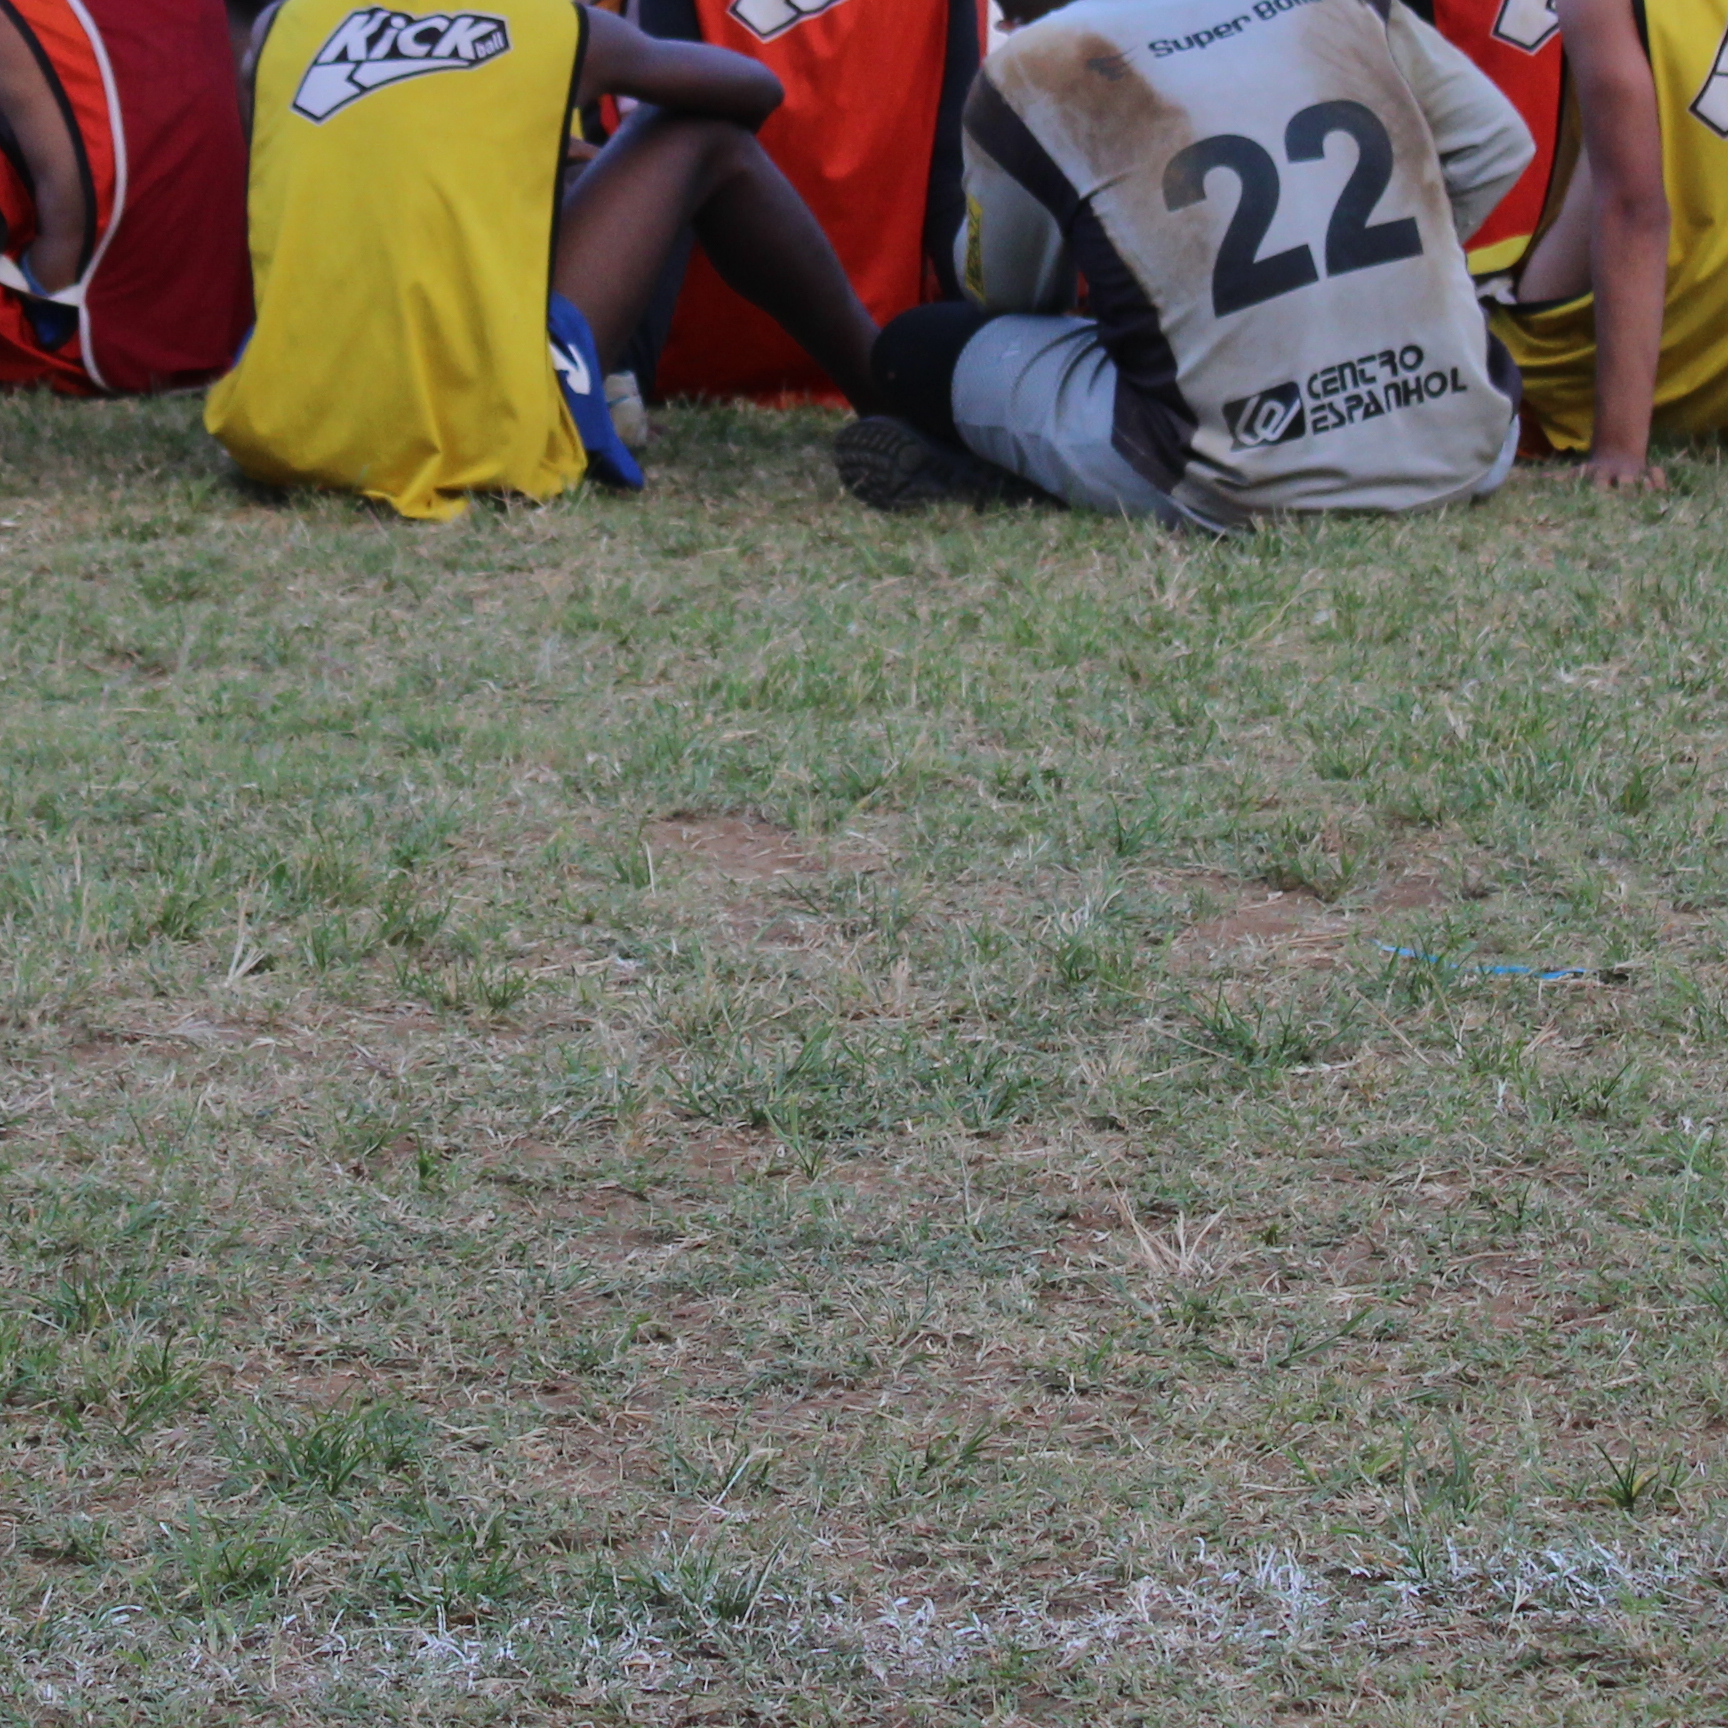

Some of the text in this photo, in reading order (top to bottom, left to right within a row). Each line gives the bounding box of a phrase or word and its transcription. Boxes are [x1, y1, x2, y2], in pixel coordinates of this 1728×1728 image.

[474, 31, 505, 59] ball
[1148, 14, 1251, 58] Super
[1162, 99, 1424, 319] 22
[1306, 344, 1424, 400] CENTRO
[1309, 367, 1469, 435] ESPANHOL
